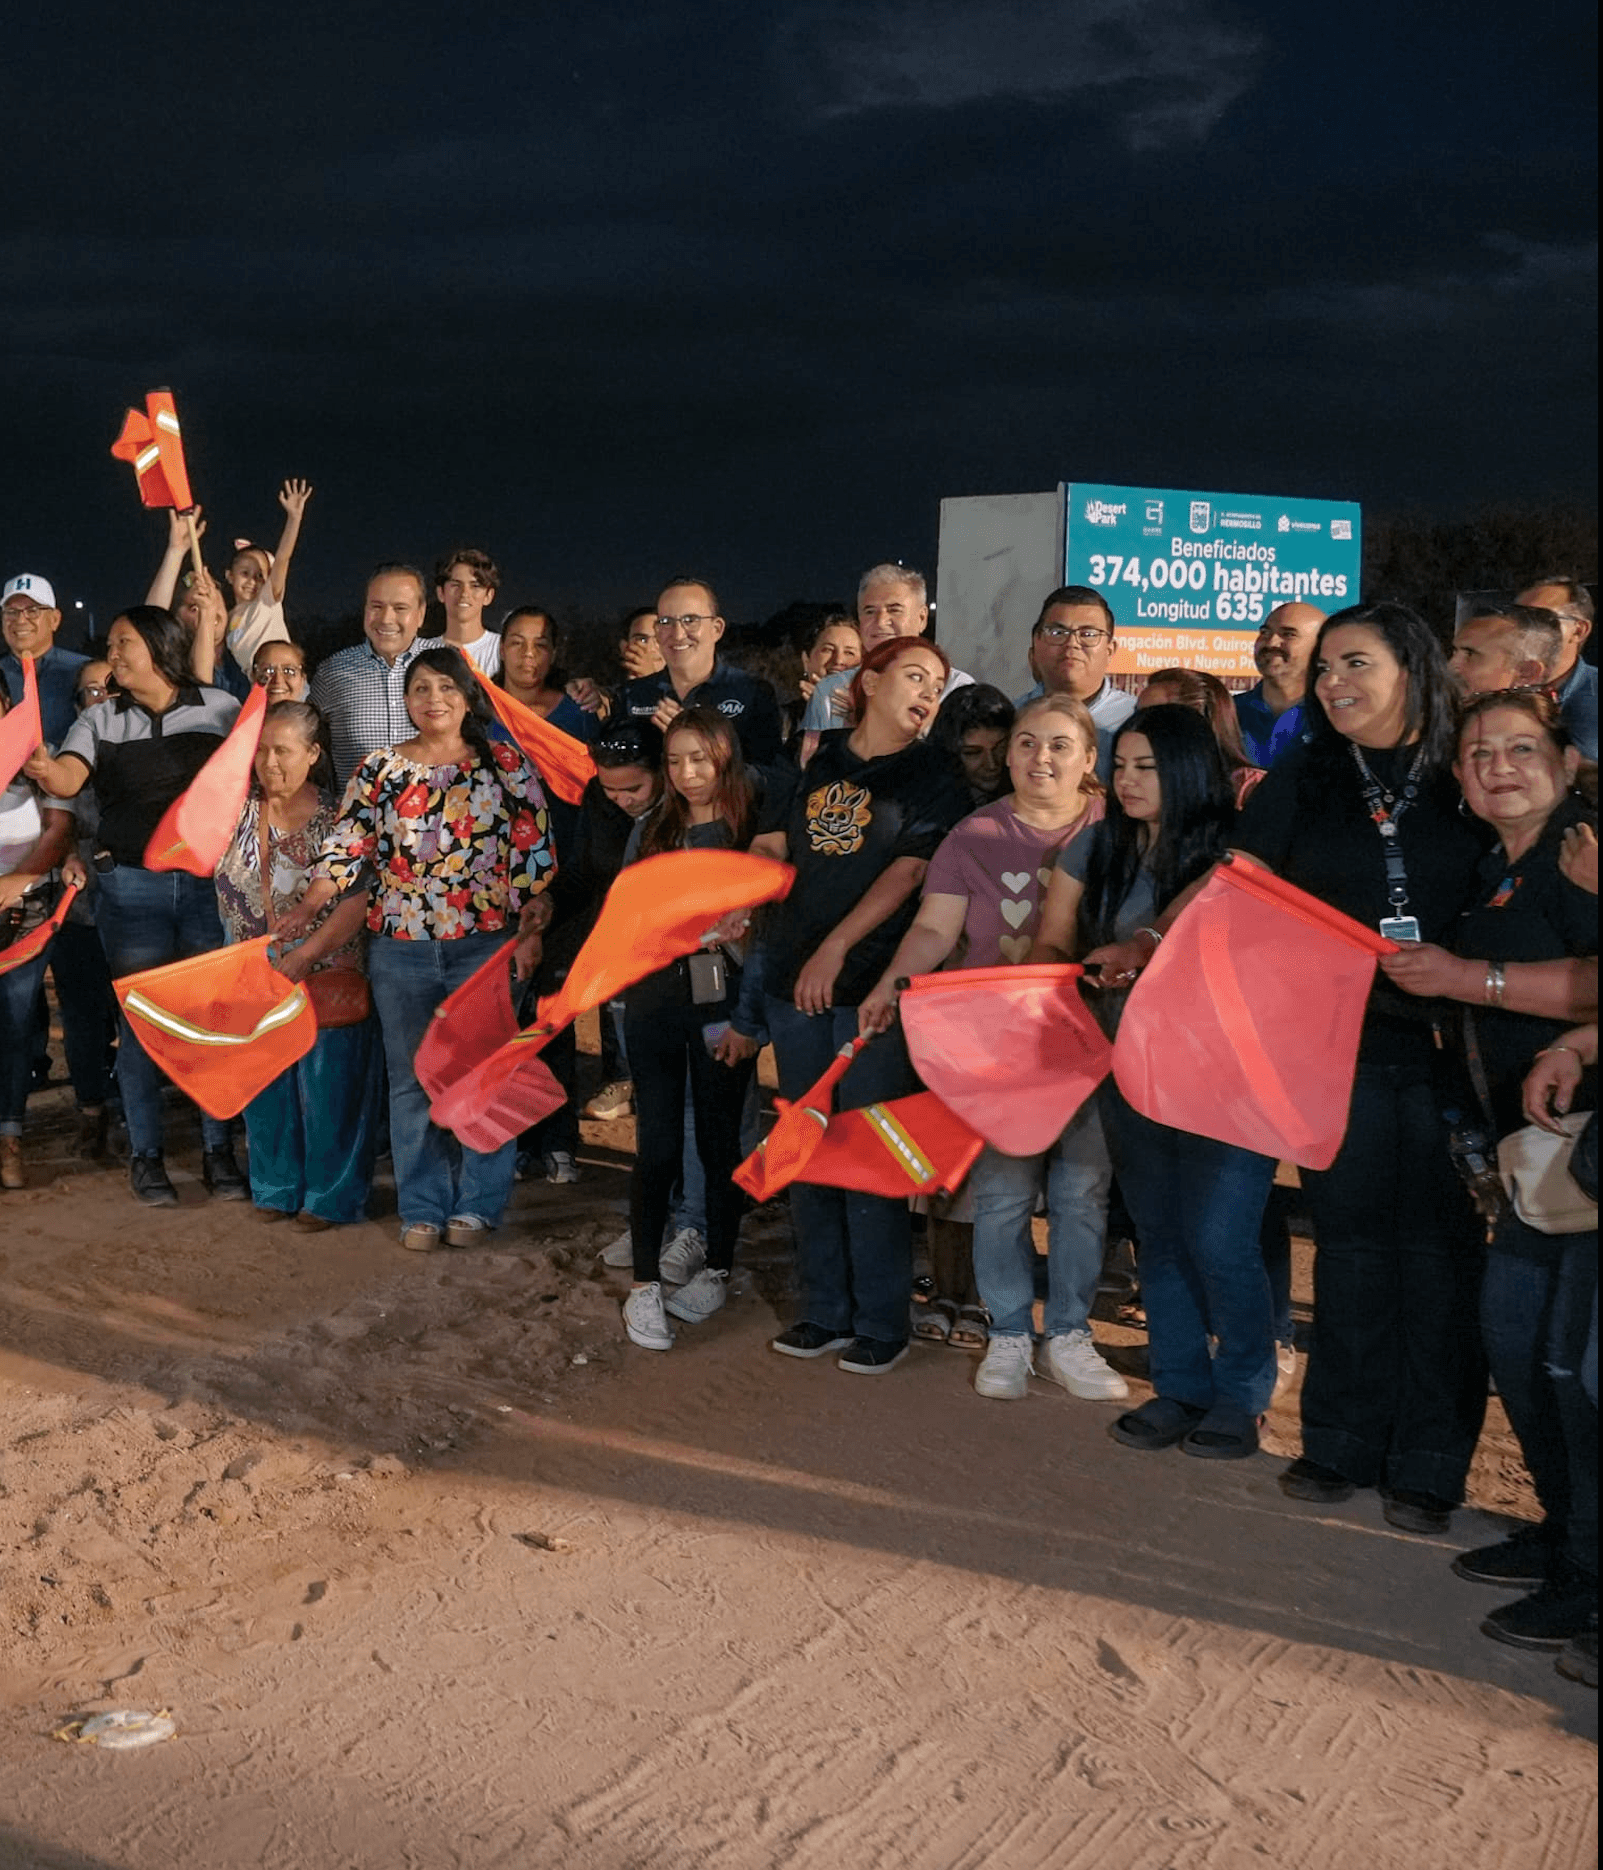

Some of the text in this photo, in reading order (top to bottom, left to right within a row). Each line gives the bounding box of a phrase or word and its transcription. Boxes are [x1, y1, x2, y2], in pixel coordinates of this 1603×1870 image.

[1095, 500, 1127, 515] Desert
[1095, 511, 1118, 527] Park
[1171, 536, 1276, 563] Beneficiados
[1088, 554, 1348, 597] 374,000 habitantes
[1136, 597, 1211, 622] Longitud
[1215, 592, 1264, 622] 635
[1176, 635, 1210, 651] Blvd.
[1136, 653, 1258, 670] Nuevo y Nuevo Pr
